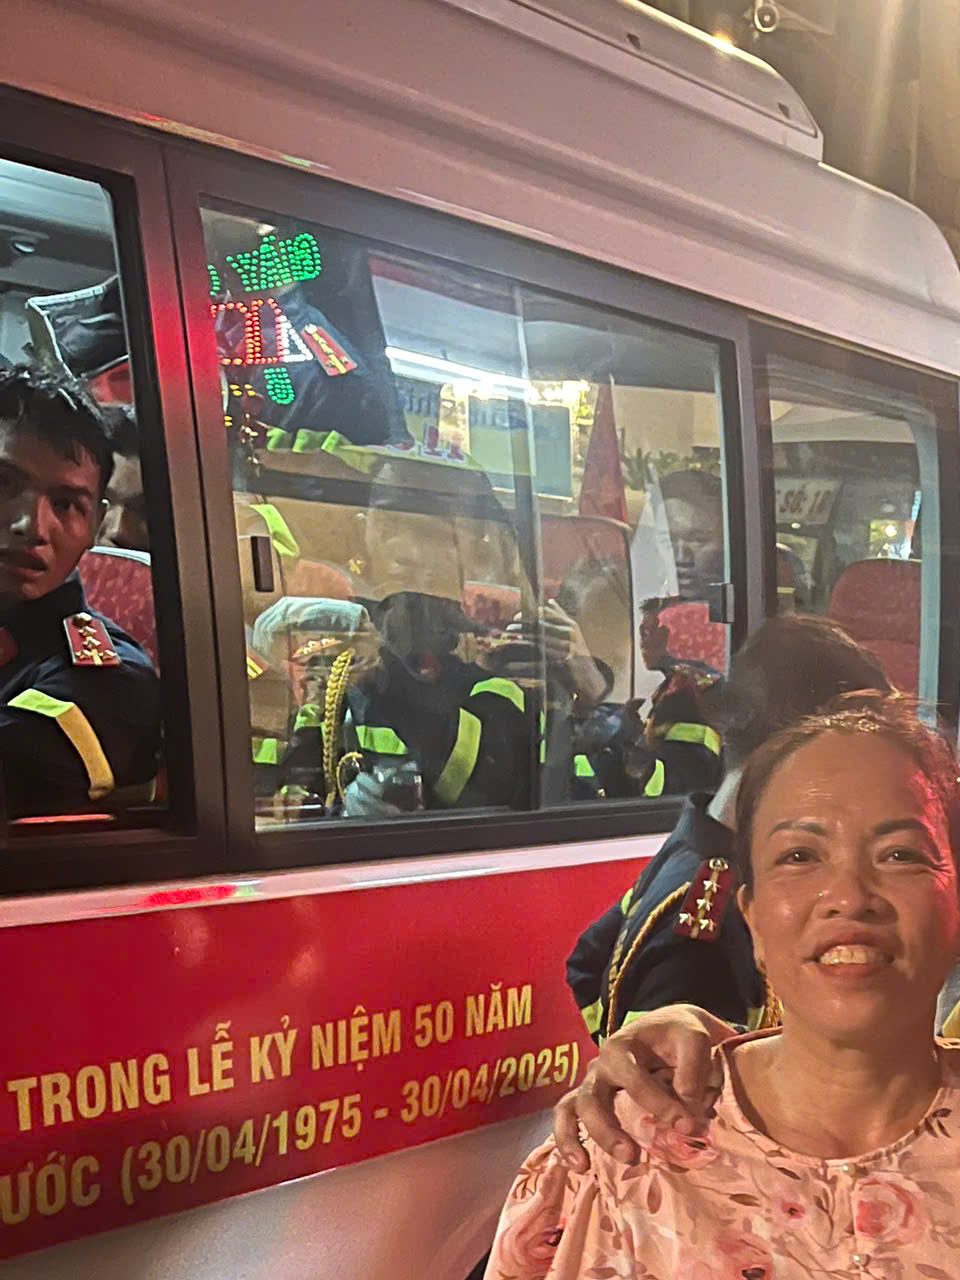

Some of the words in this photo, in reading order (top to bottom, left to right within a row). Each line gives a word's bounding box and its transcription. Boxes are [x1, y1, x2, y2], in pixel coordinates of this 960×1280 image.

[7, 1053, 171, 1132] TRONG
[187, 1020, 235, 1097] LỄ
[250, 1015, 298, 1084] KỶ
[311, 1005, 401, 1071] NIỆM
[415, 1001, 455, 1049] 50
[465, 981, 532, 1038] NĂM
[121, 1093, 362, 1206] (30/04/1975
[374, 1106, 389, 1120] -
[401, 1041, 580, 1123] 30/04/2025)
